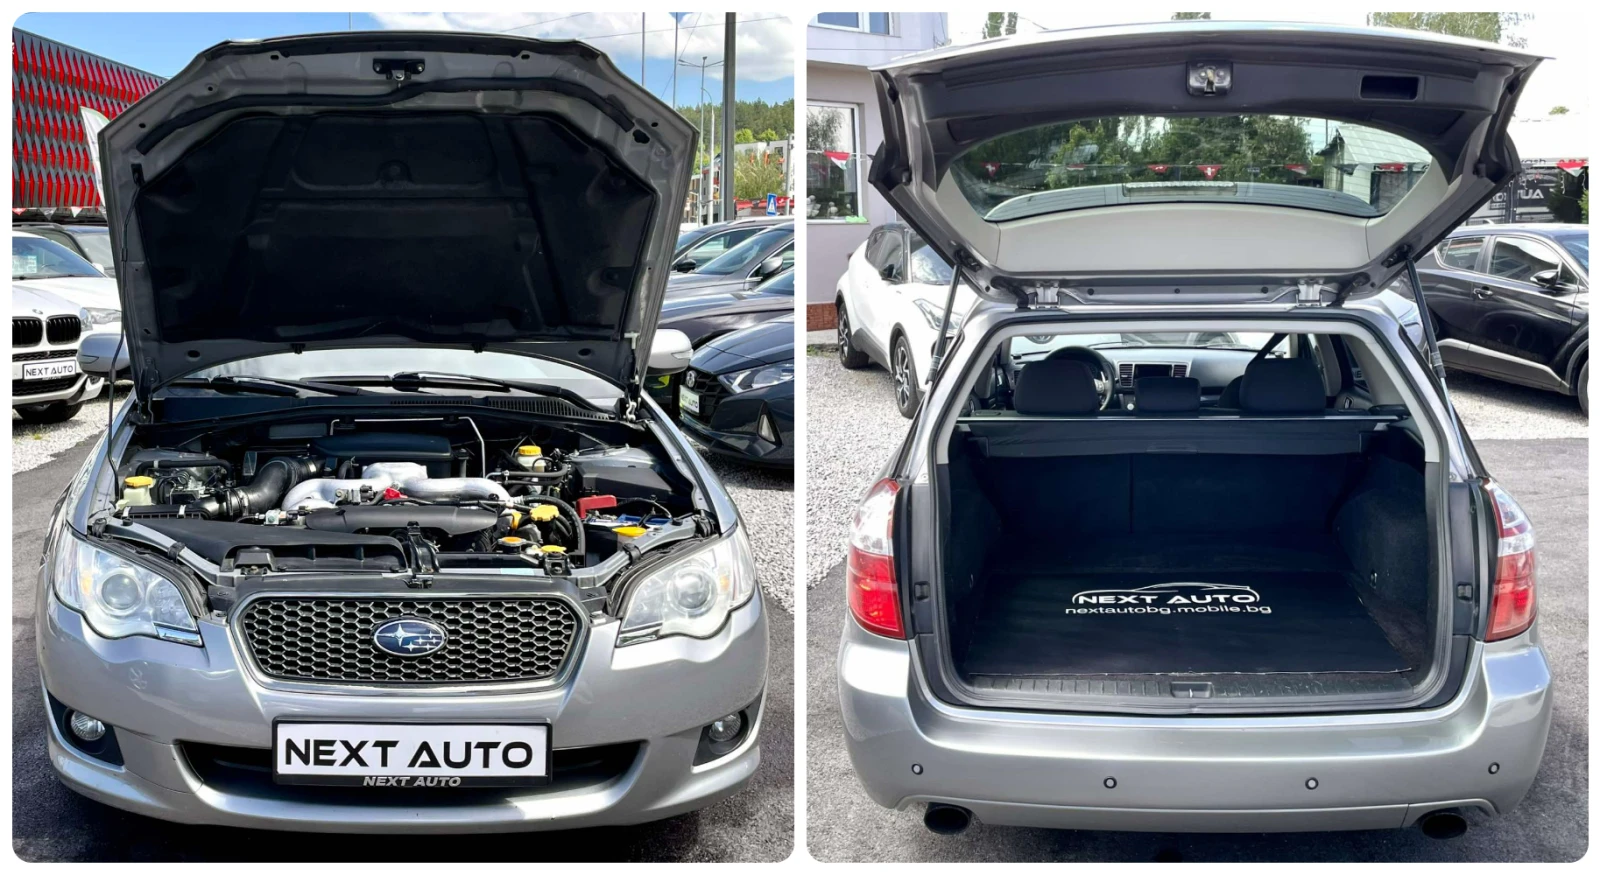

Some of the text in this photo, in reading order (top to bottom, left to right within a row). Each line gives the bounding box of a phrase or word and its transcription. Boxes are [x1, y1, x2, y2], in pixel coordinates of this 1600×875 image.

[26, 365, 73, 376] NEXT AUTO
[1079, 594, 1255, 604] NEXT AUTO
[1065, 605, 1272, 614] nextautobg.mobile.bg
[285, 738, 533, 769] NEXT AUTO
[362, 776, 461, 787] NEXT AUTO
